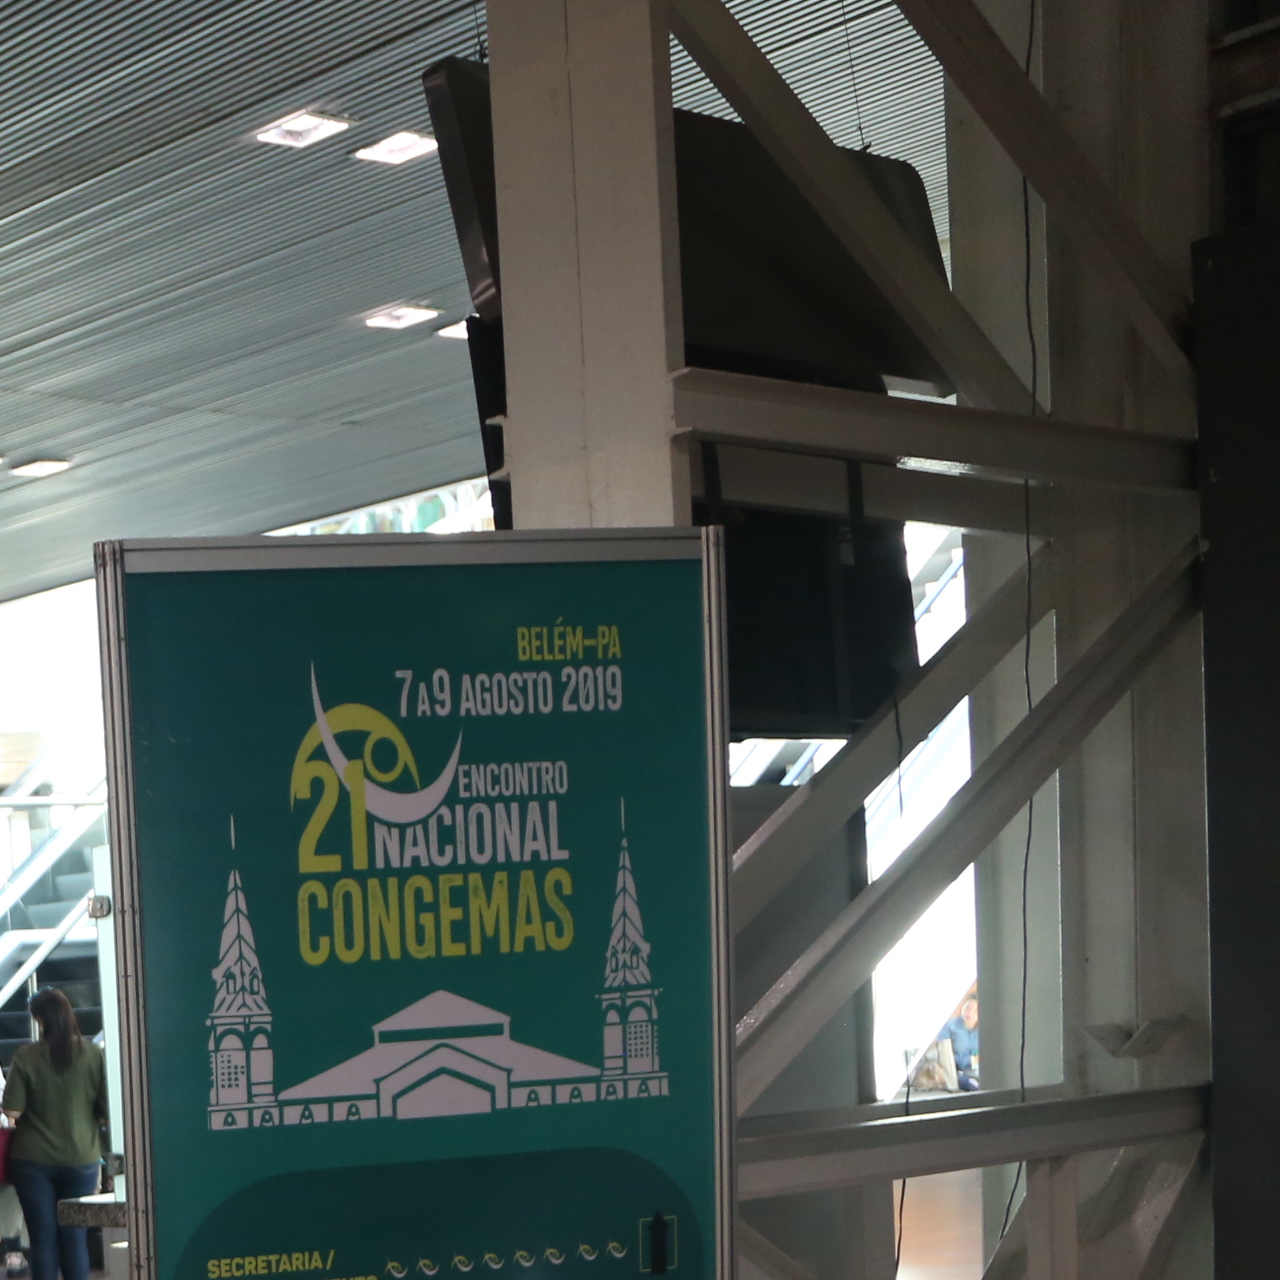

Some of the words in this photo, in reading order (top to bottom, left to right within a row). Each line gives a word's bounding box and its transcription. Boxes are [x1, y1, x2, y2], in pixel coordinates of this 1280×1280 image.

[460, 671, 553, 716] AGOSTO
[561, 665, 623, 712] 2019
[459, 761, 568, 798] ENCONTRO
[374, 801, 570, 868] NACIONAL
[296, 867, 575, 966] CONGEMAS
[207, 1250, 323, 1278] SECRETARIA
